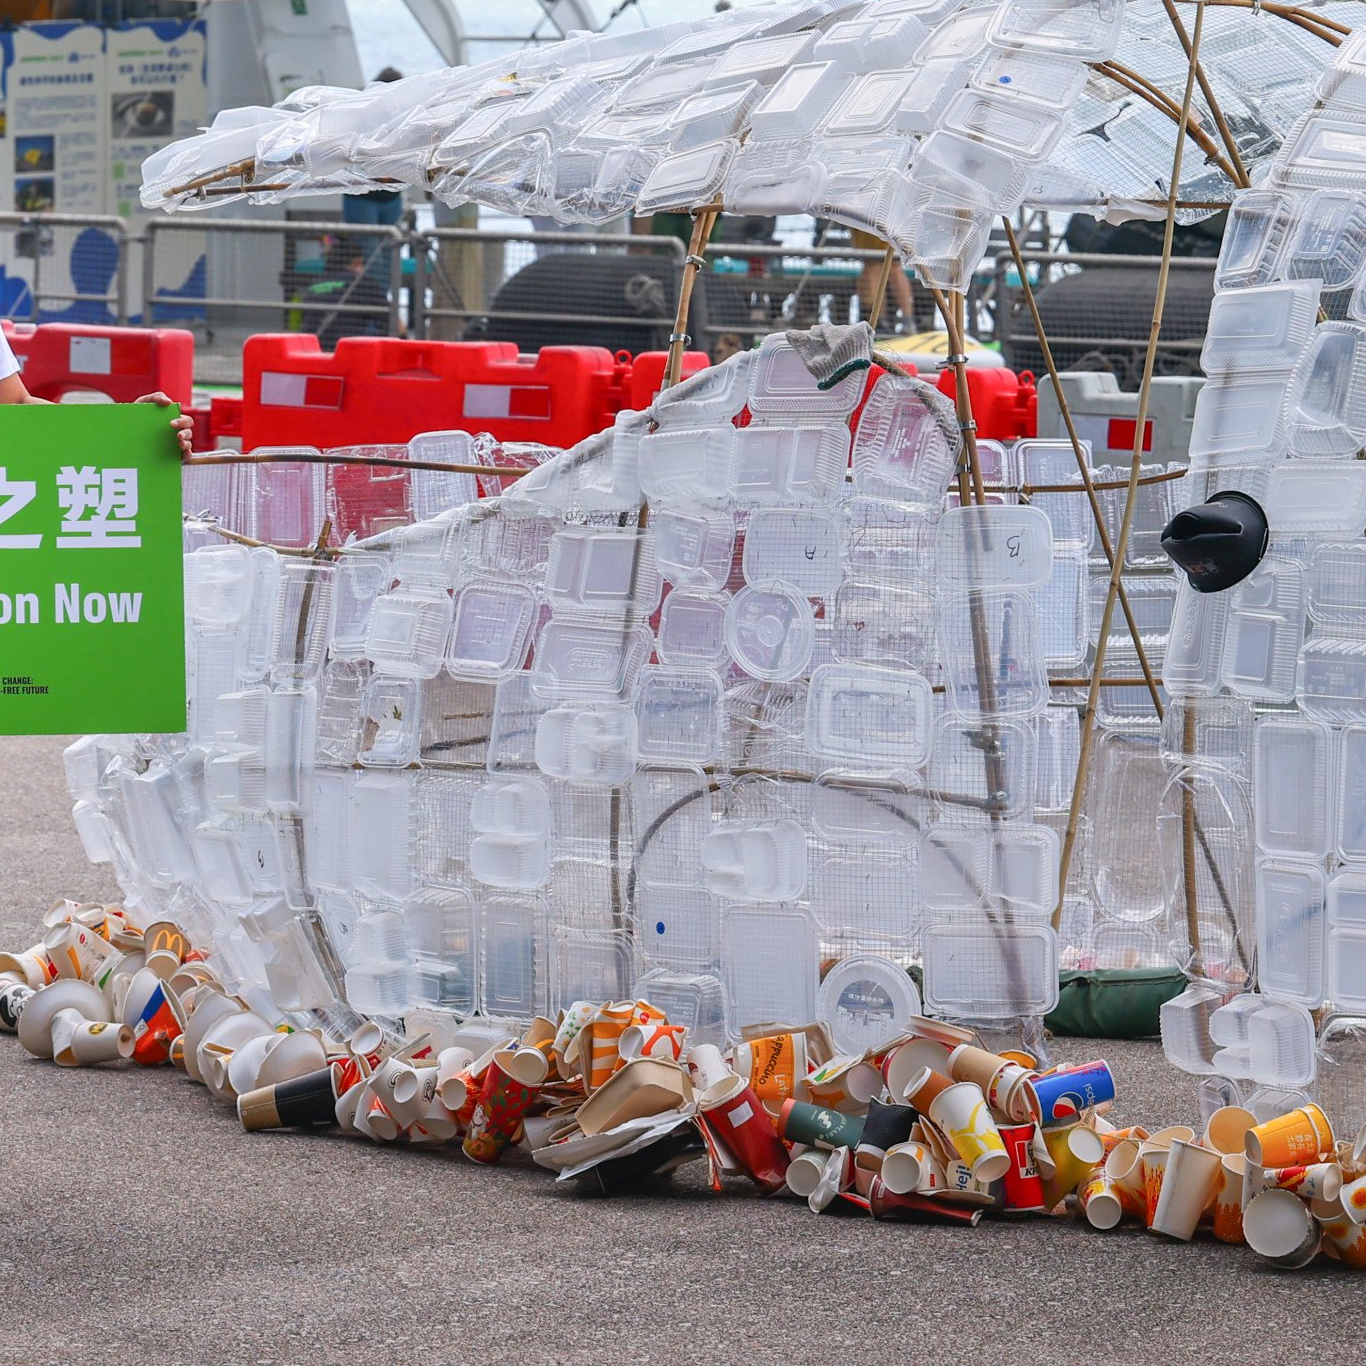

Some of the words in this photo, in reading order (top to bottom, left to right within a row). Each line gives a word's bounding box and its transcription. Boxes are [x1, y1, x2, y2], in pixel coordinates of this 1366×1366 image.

[55, 583, 142, 623] Now
[2, 677, 33, 685] CHANGE:
[22, 686, 49, 694] FUTURE
